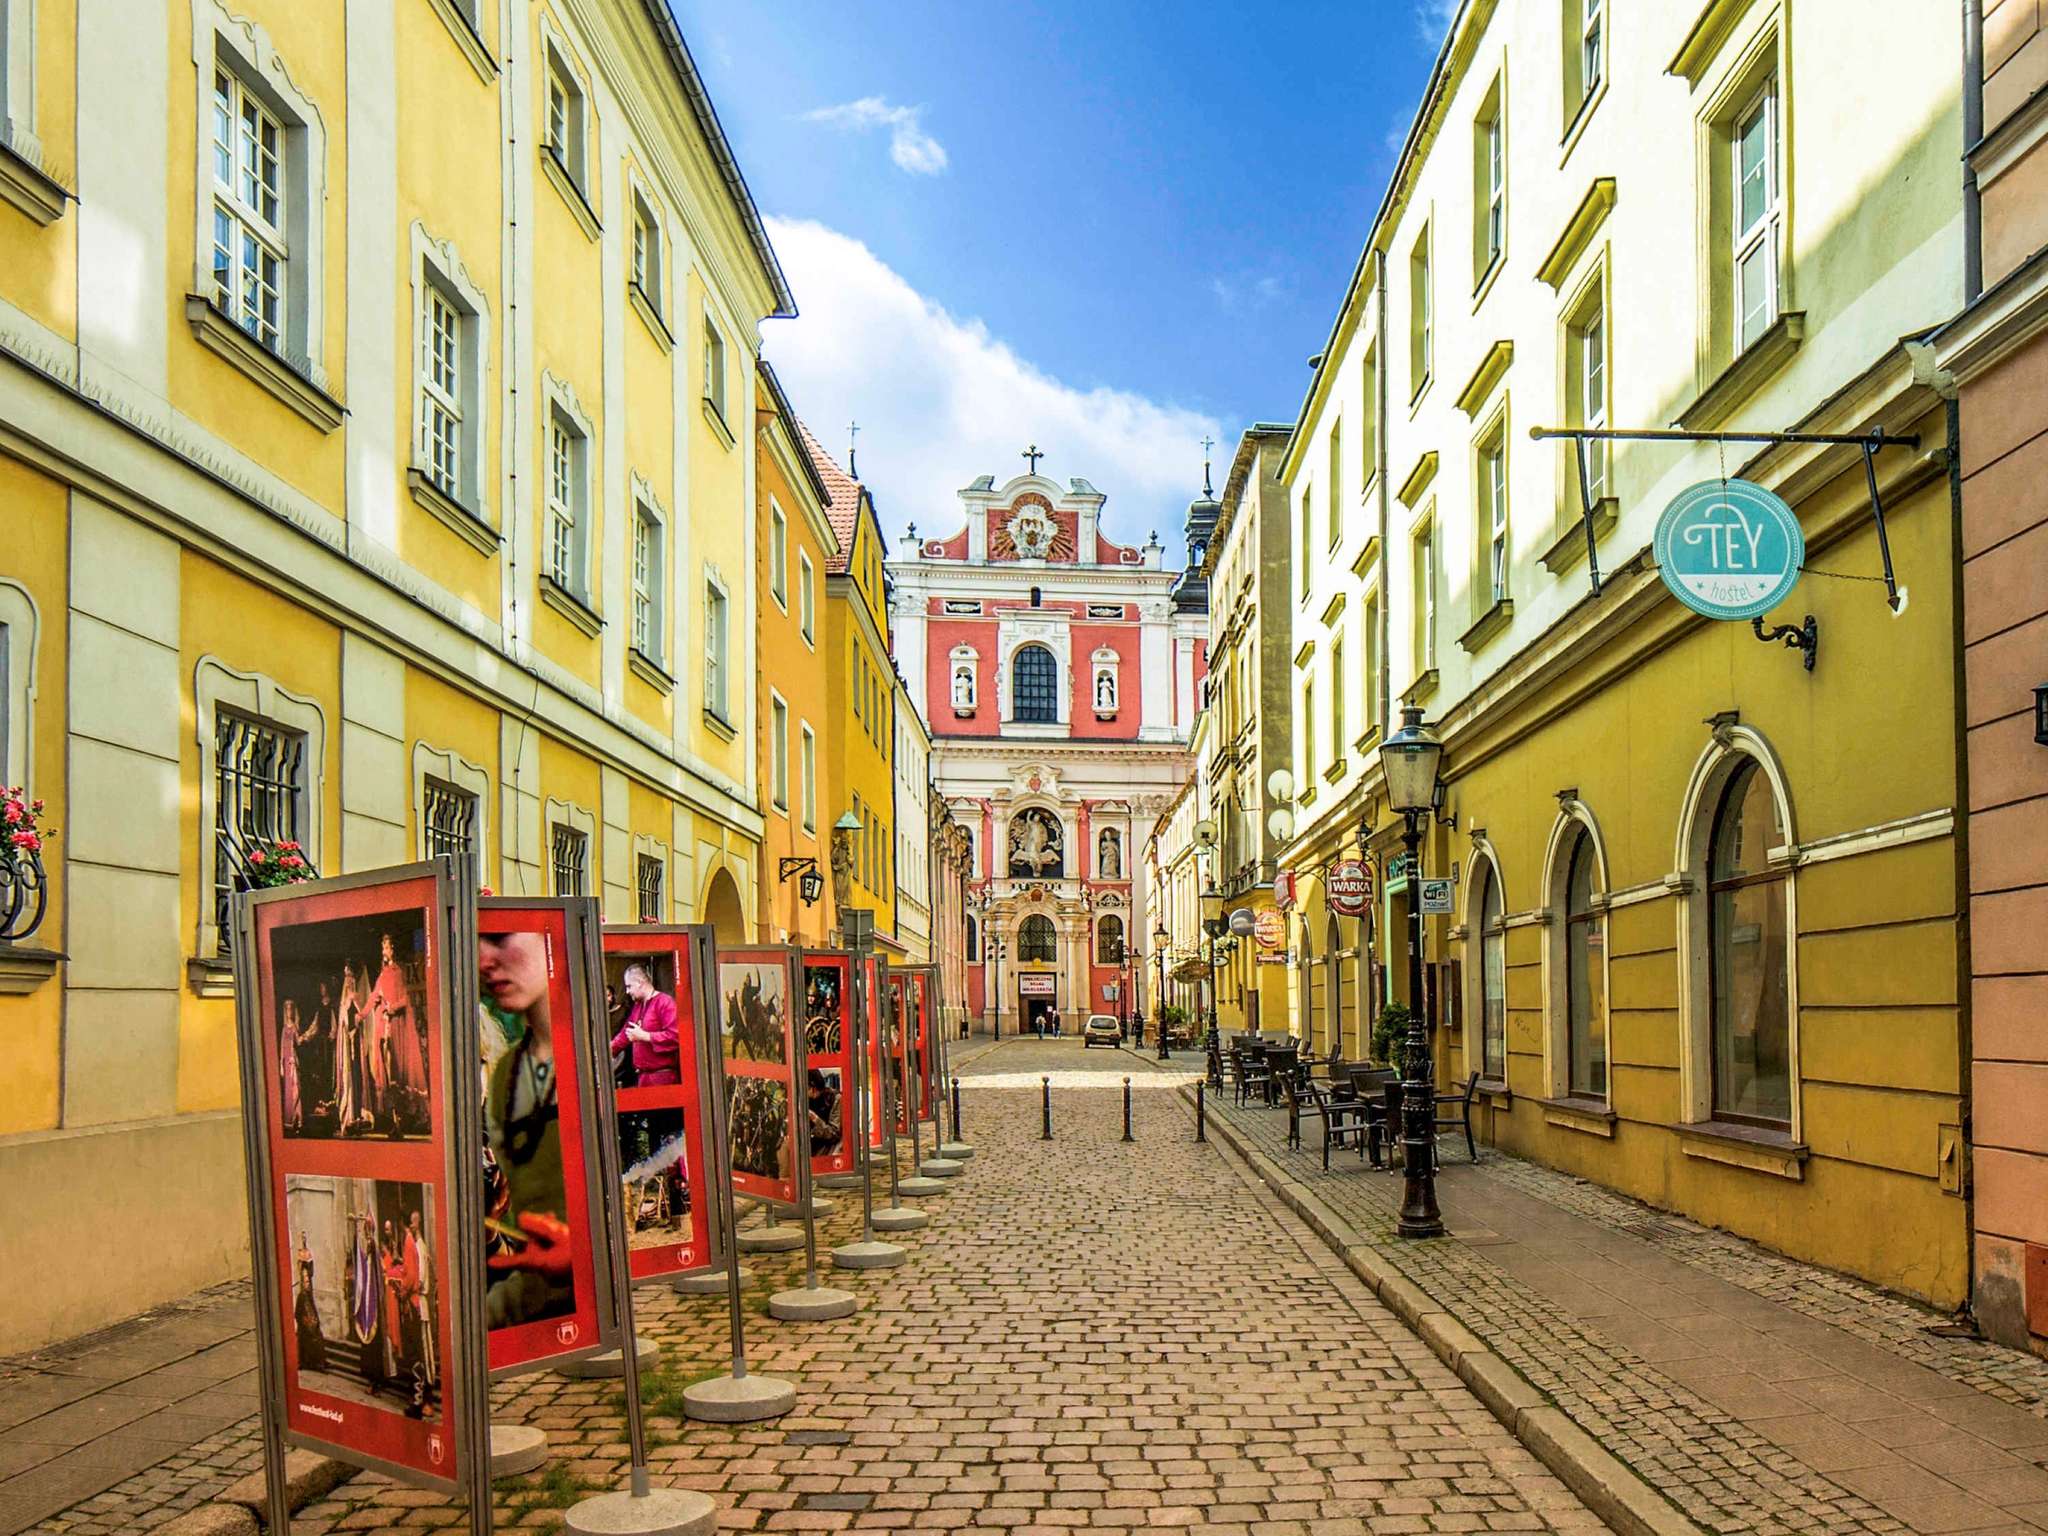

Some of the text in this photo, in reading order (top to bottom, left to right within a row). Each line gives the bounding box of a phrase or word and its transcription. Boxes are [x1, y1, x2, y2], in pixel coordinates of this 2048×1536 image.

[1683, 503, 1763, 569] TEY
[1711, 582, 1754, 602] hostel
[806, 881, 813, 890] 2
[1333, 881, 1371, 892] WARKA
